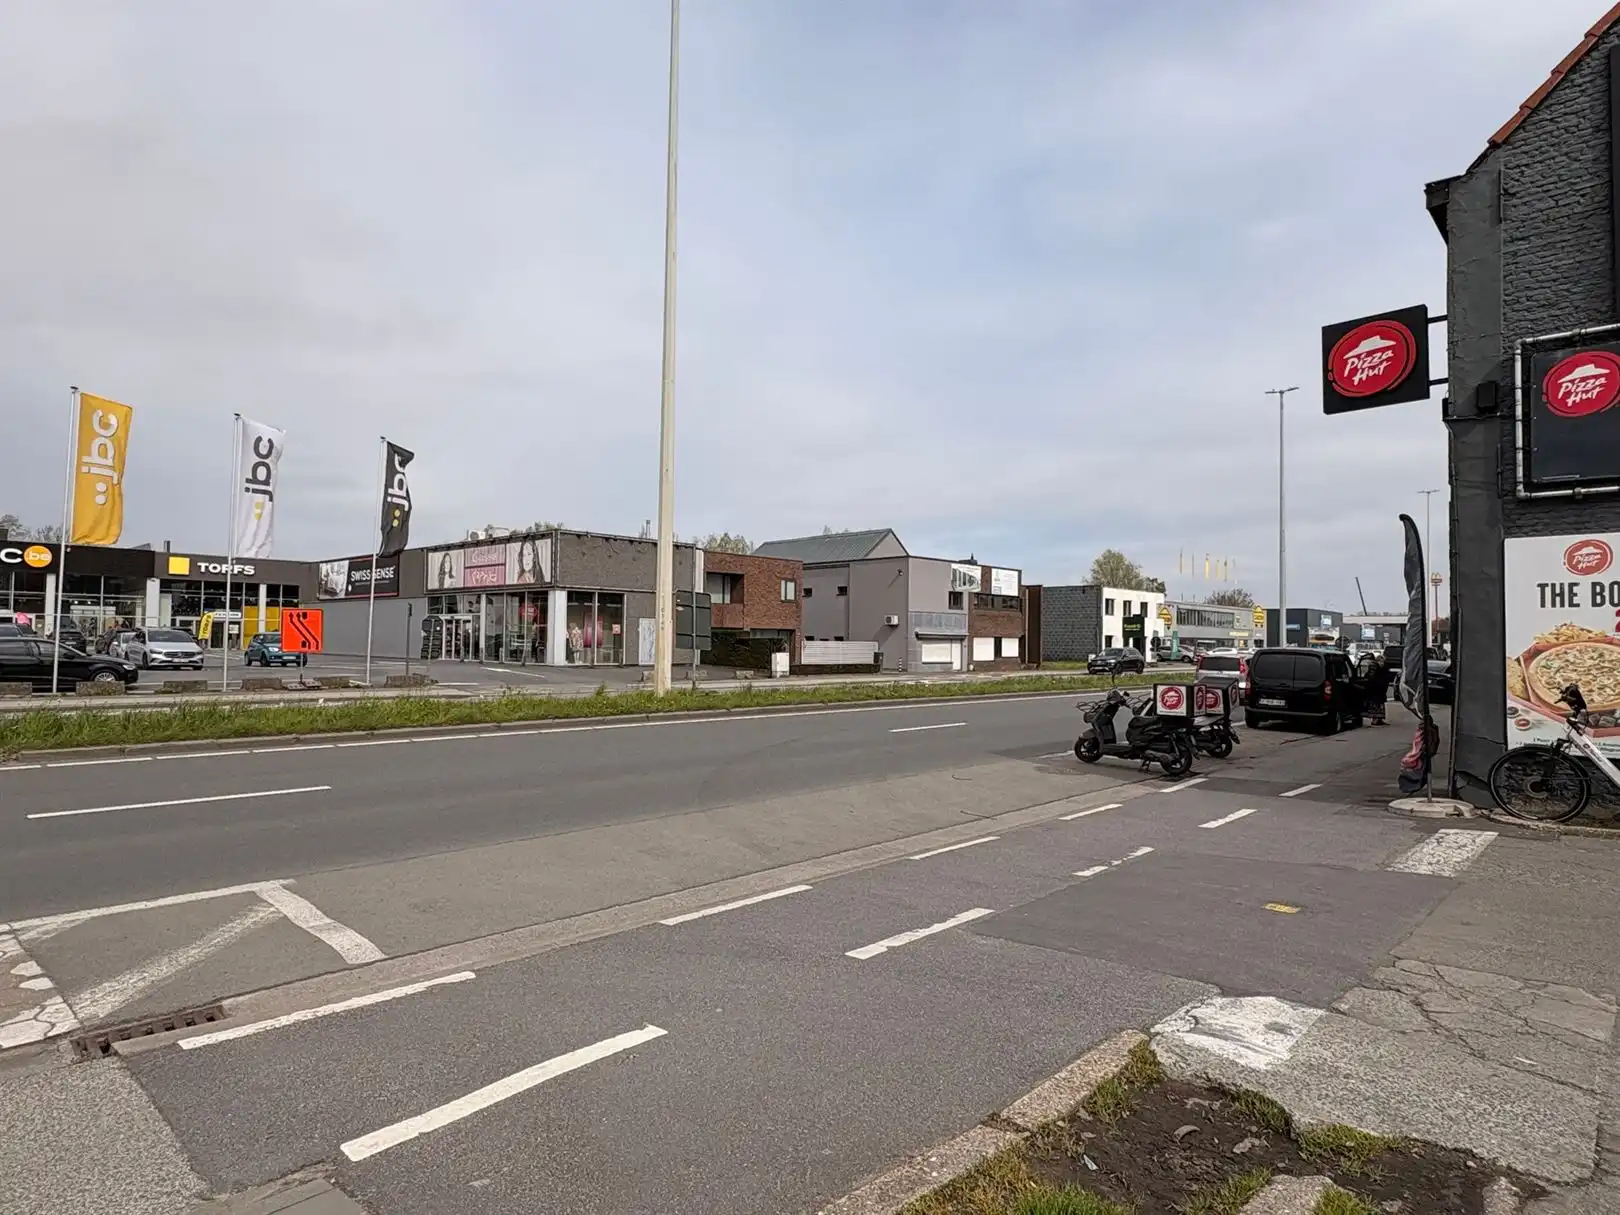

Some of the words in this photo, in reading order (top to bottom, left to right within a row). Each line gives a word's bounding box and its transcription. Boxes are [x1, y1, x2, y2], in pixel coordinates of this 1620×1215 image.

[1343, 350, 1394, 377] Pizza
[1352, 361, 1391, 385] Hut
[1558, 377, 1608, 399] Pizza
[1566, 386, 1606, 407] Hut
[197, 562, 256, 575] TORFS
[351, 569, 371, 582] SWISS
[1537, 582, 1581, 608] THE
